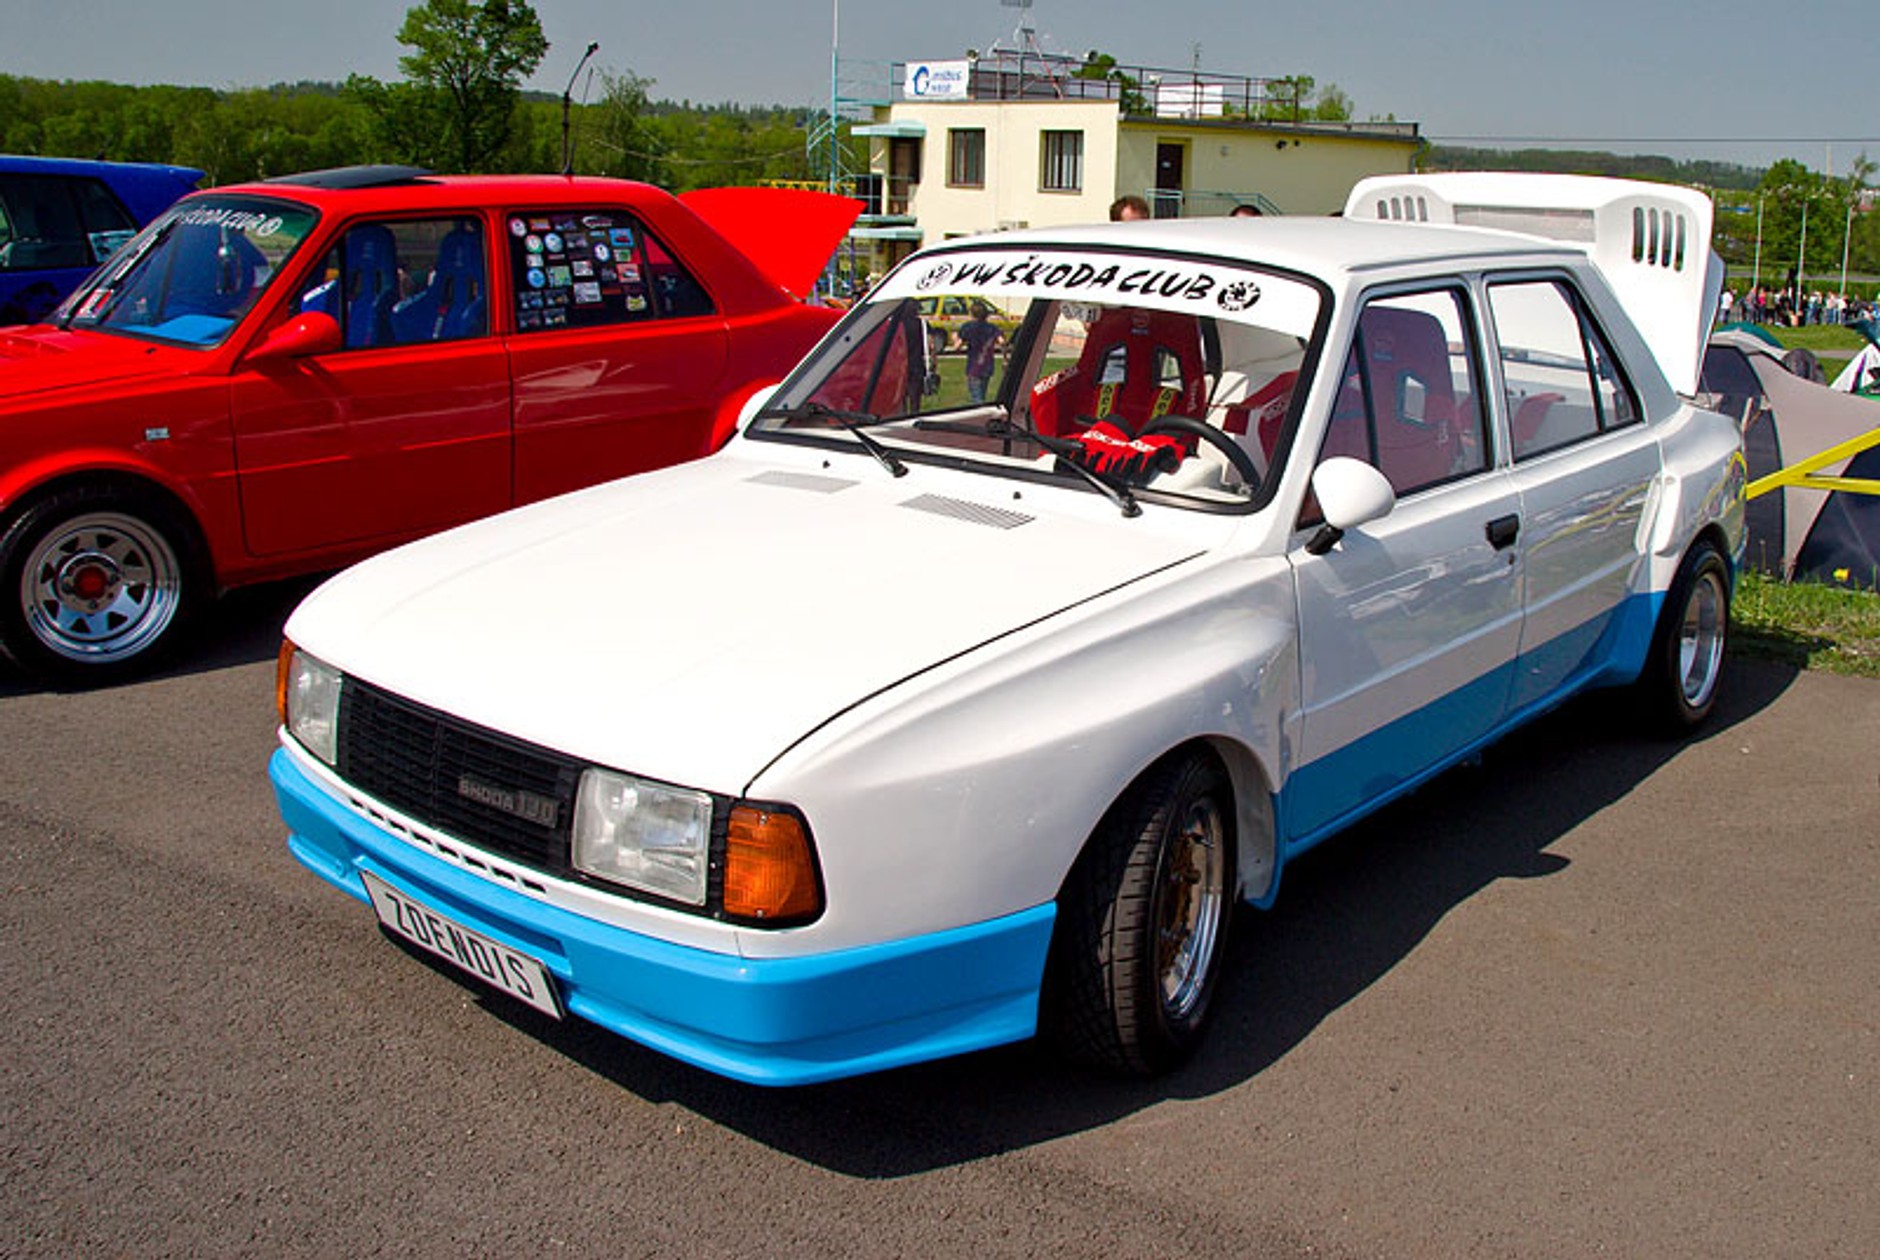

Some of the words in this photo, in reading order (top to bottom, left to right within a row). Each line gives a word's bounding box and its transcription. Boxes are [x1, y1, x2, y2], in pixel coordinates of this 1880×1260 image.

[950, 261, 1007, 287] VW
[1001, 254, 1120, 289] ŠKODA
[1117, 269, 1216, 300] CLUB
